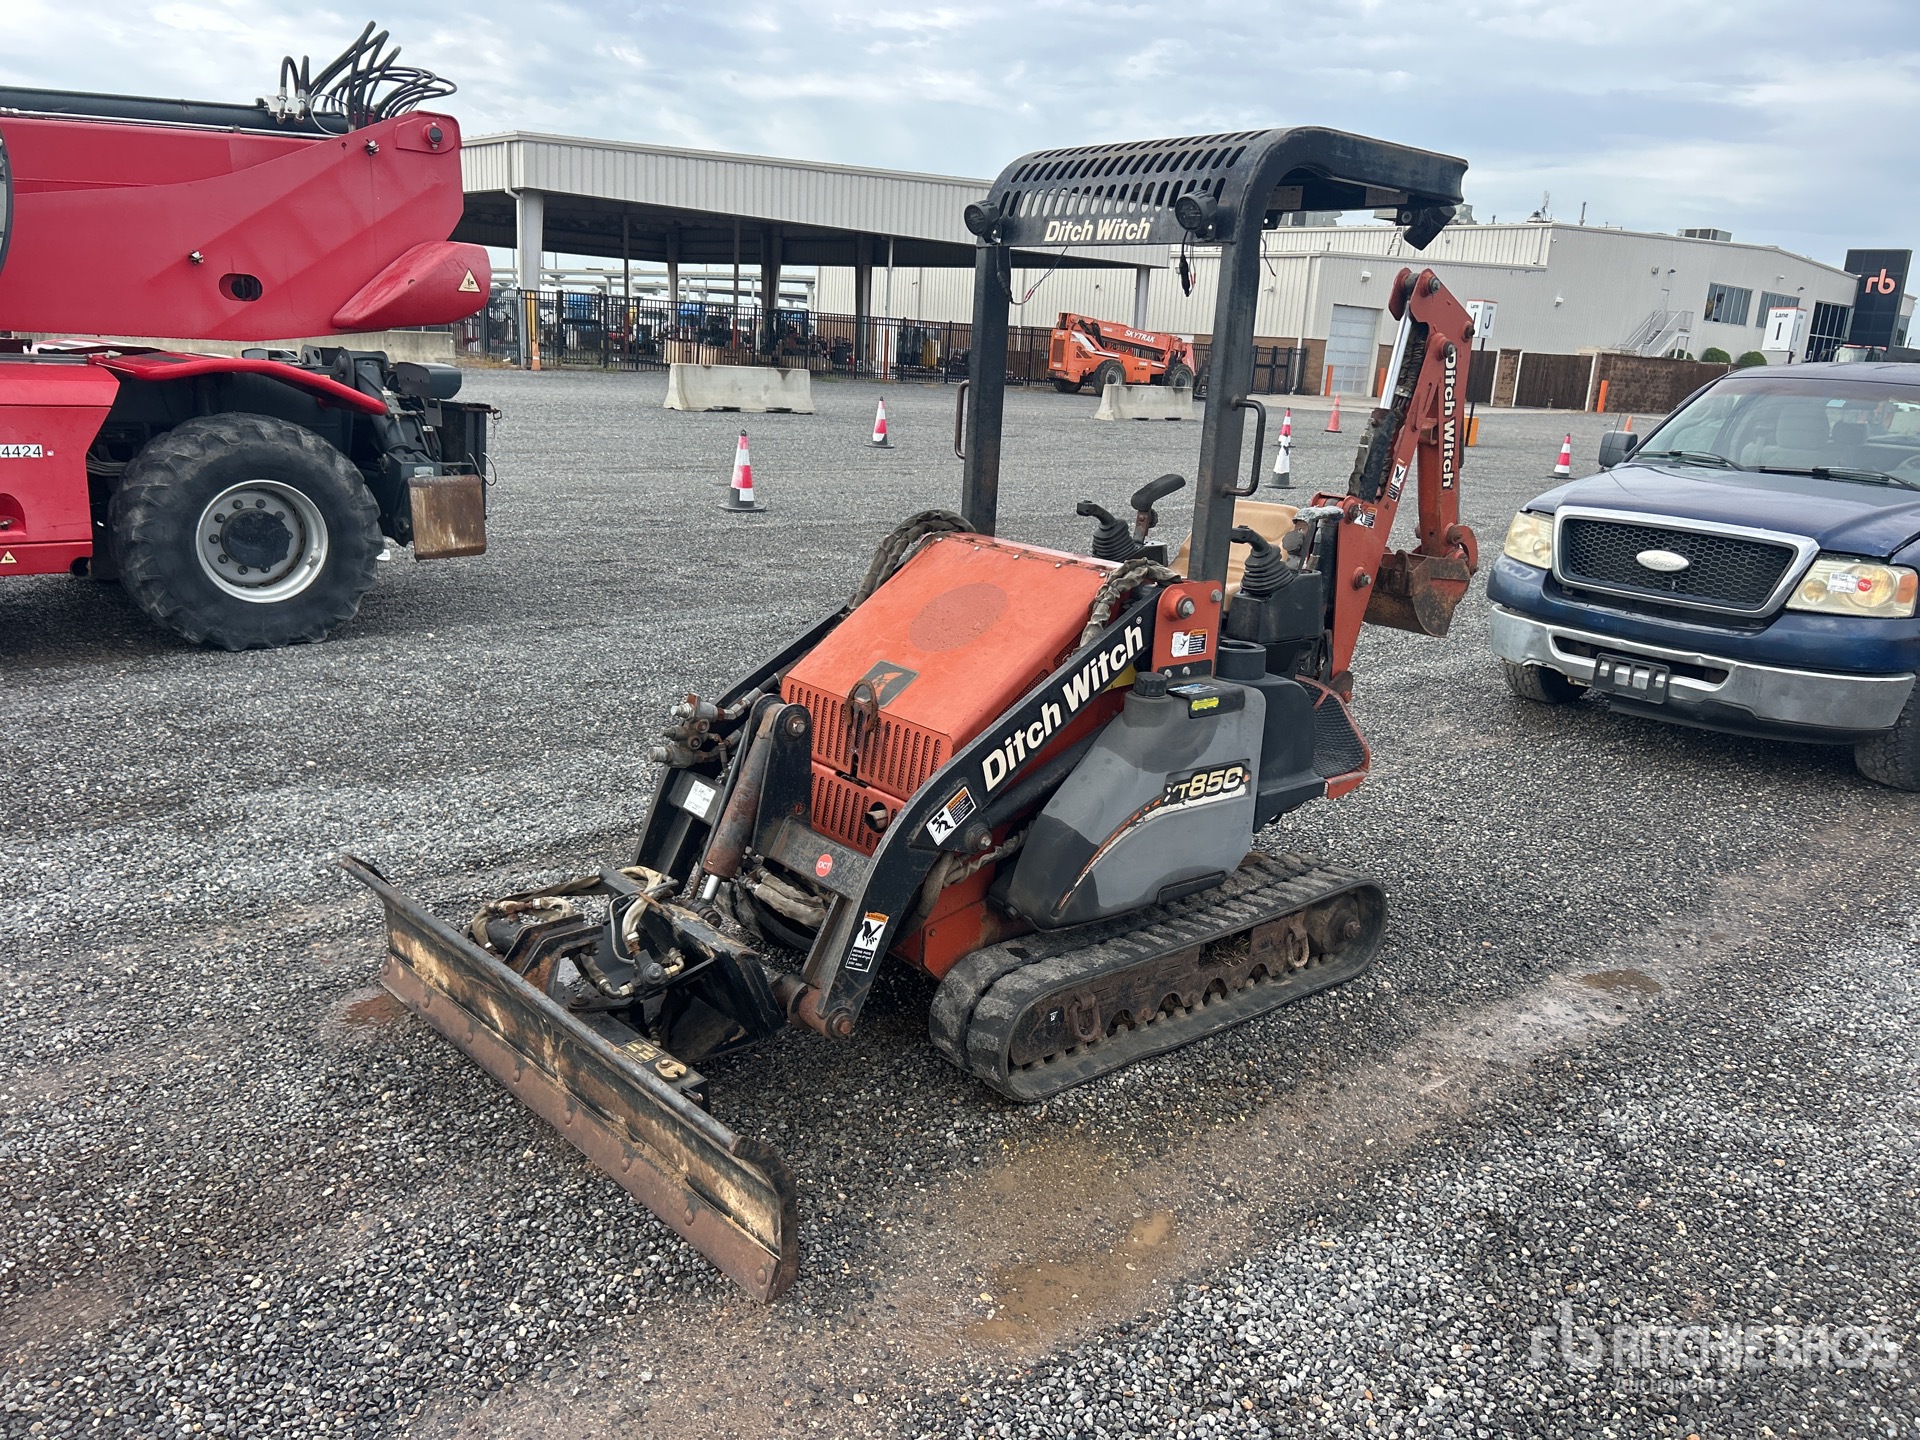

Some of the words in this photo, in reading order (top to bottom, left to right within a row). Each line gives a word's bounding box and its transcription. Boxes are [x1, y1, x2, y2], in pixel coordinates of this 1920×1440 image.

[1044, 220, 1094, 242] Ditch
[1865, 268, 1896, 295] rb
[1484, 313, 1492, 330] J
[1124, 329, 1156, 343] SKYTRAK
[1775, 322, 1782, 341] I
[1444, 351, 1457, 416] Ditch
[0, 445, 42, 458] 4424
[1858, 581, 1871, 590] OCT
[981, 702, 1062, 792] Ditch
[817, 860, 831, 871] OCT
